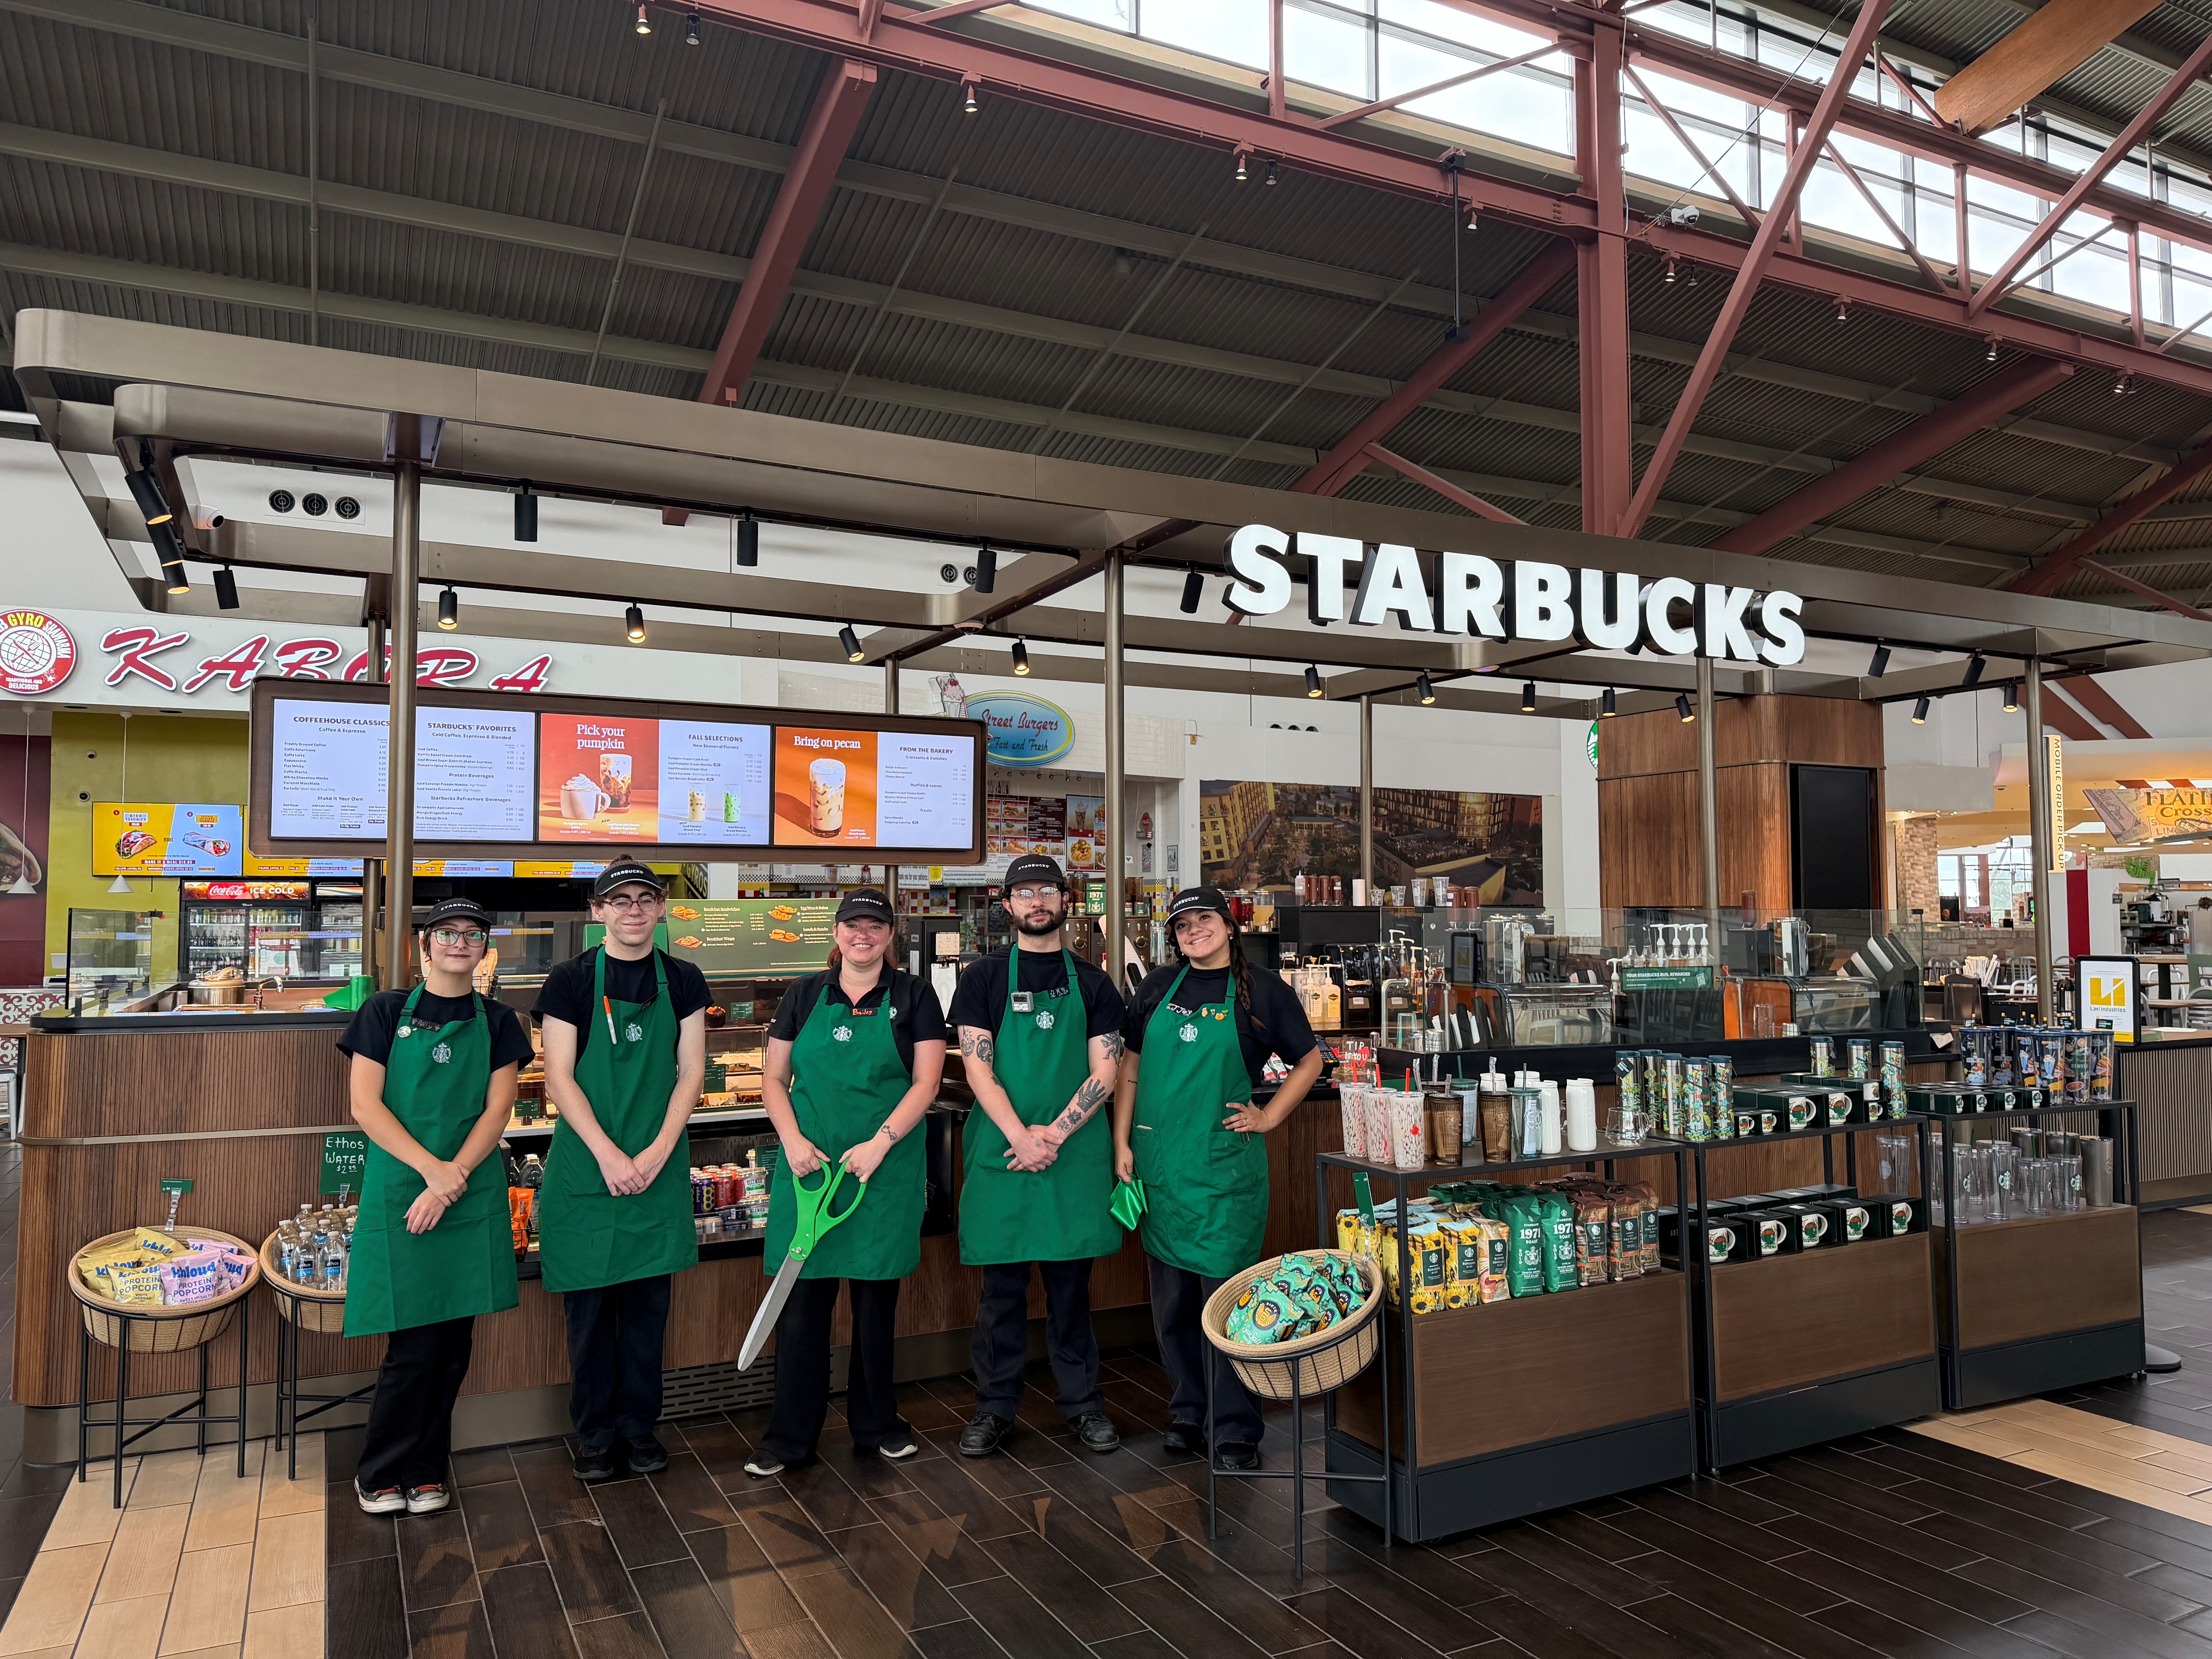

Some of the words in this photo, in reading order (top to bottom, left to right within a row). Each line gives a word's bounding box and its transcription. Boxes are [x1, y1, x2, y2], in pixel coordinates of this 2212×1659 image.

[1223, 524, 1805, 667] STARBUCKS
[7, 613, 44, 627] GYRO
[43, 621, 71, 658] SHAWARMA
[982, 709, 1013, 728] Street
[1018, 712, 1058, 737] Burgers
[577, 724, 600, 735] Pick
[601, 727, 625, 737] your
[577, 738, 625, 750] pumpkin
[794, 736, 820, 749] Bring
[834, 740, 861, 749] pecan
[994, 737, 1008, 749] Fast
[1012, 738, 1026, 750] and
[1029, 739, 1048, 751] Fresh
[2059, 854, 2064, 869] UP
[1346, 1041, 1364, 1050] TIP
[1353, 1052, 1367, 1060] YOU
[326, 1137, 364, 1149] Ethos
[326, 1151, 364, 1165] WATER
[1520, 1227, 1540, 1239] 1971
[1553, 1223, 1573, 1234] 1971
[171, 1261, 216, 1278] khloud
[124, 1278, 161, 1286] PROTEIN
[179, 1278, 212, 1288] PROTEIN
[119, 1284, 163, 1295] POPCORN
[173, 1285, 216, 1297] POPCORN
